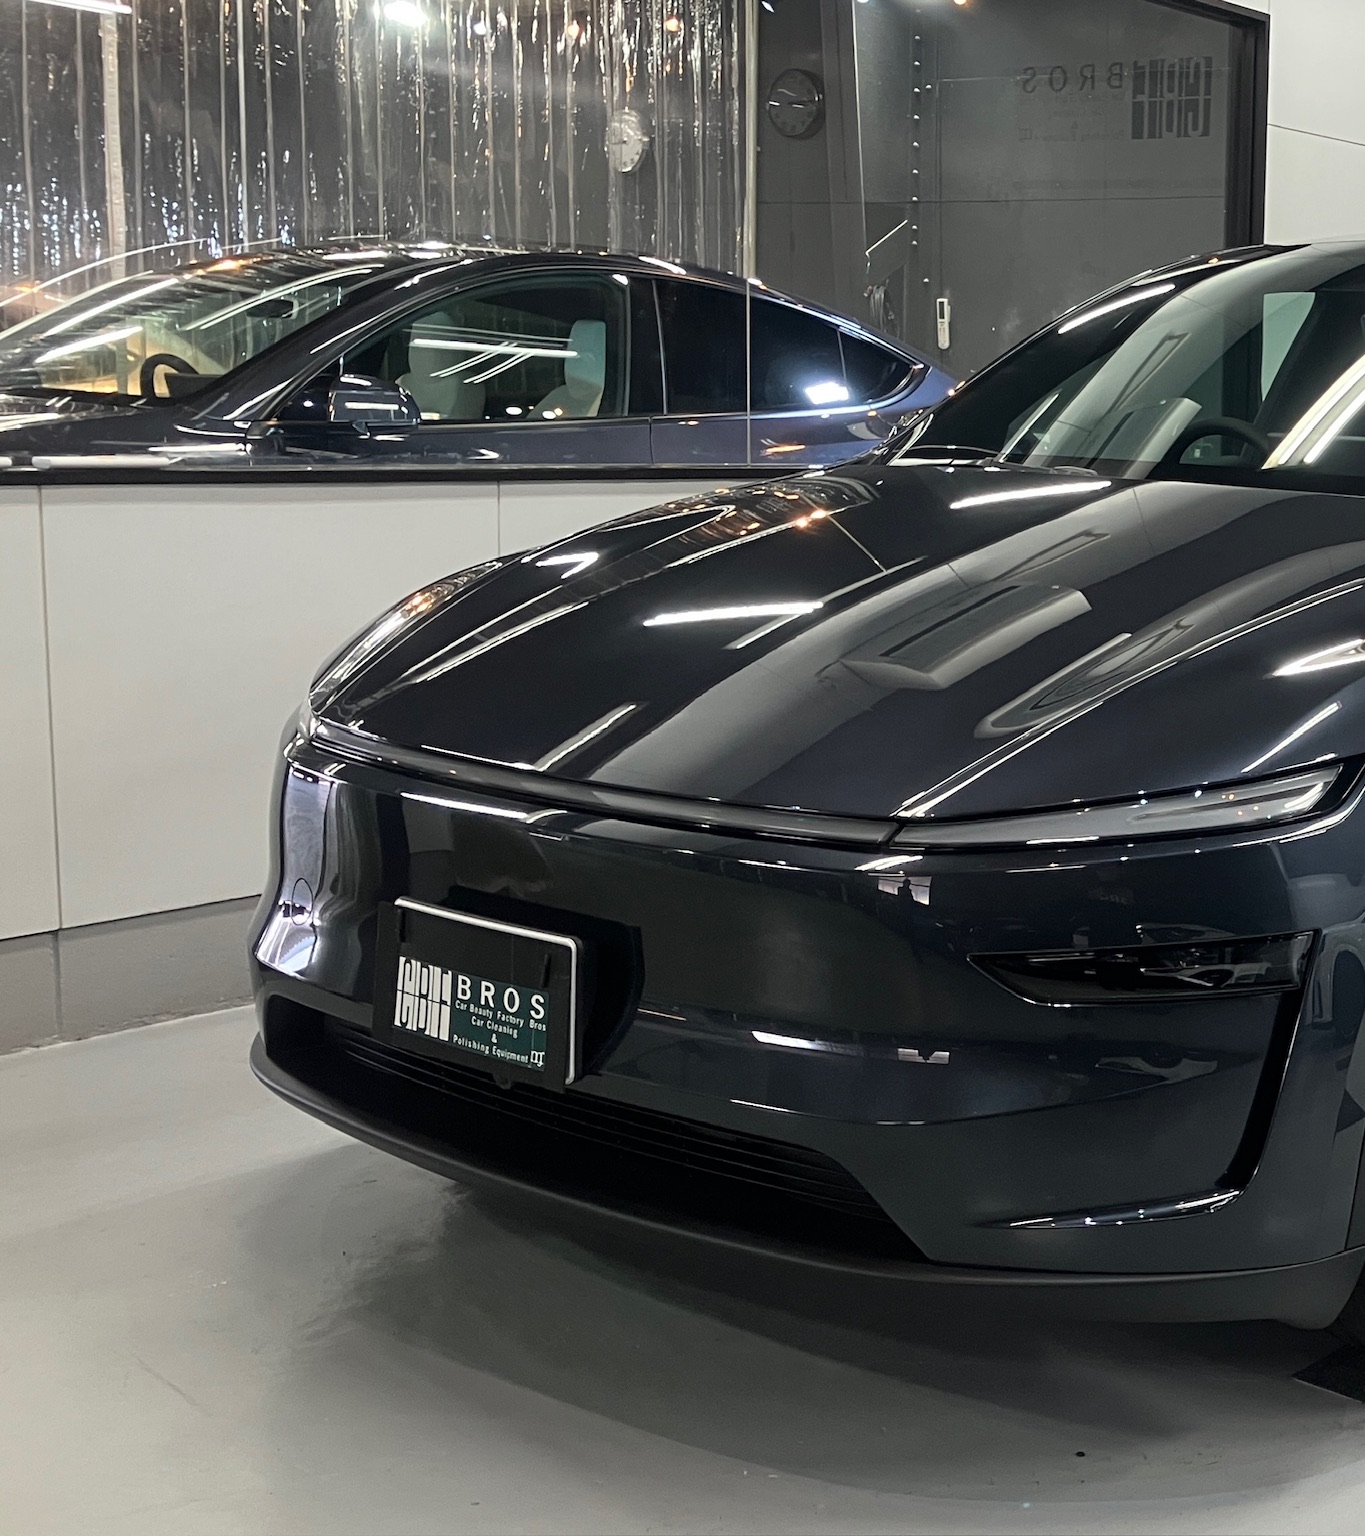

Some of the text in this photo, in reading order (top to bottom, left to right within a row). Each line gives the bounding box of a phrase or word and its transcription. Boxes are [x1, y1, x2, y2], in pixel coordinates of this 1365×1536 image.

[457, 974, 545, 1020] BROS
[455, 1000, 546, 1031] Car Beauty Factory Bros
[471, 1016, 518, 1039] Car Cleaning
[453, 1034, 489, 1055] Polishing
[492, 1045, 528, 1063] Equipment
[491, 1033, 498, 1043] &
